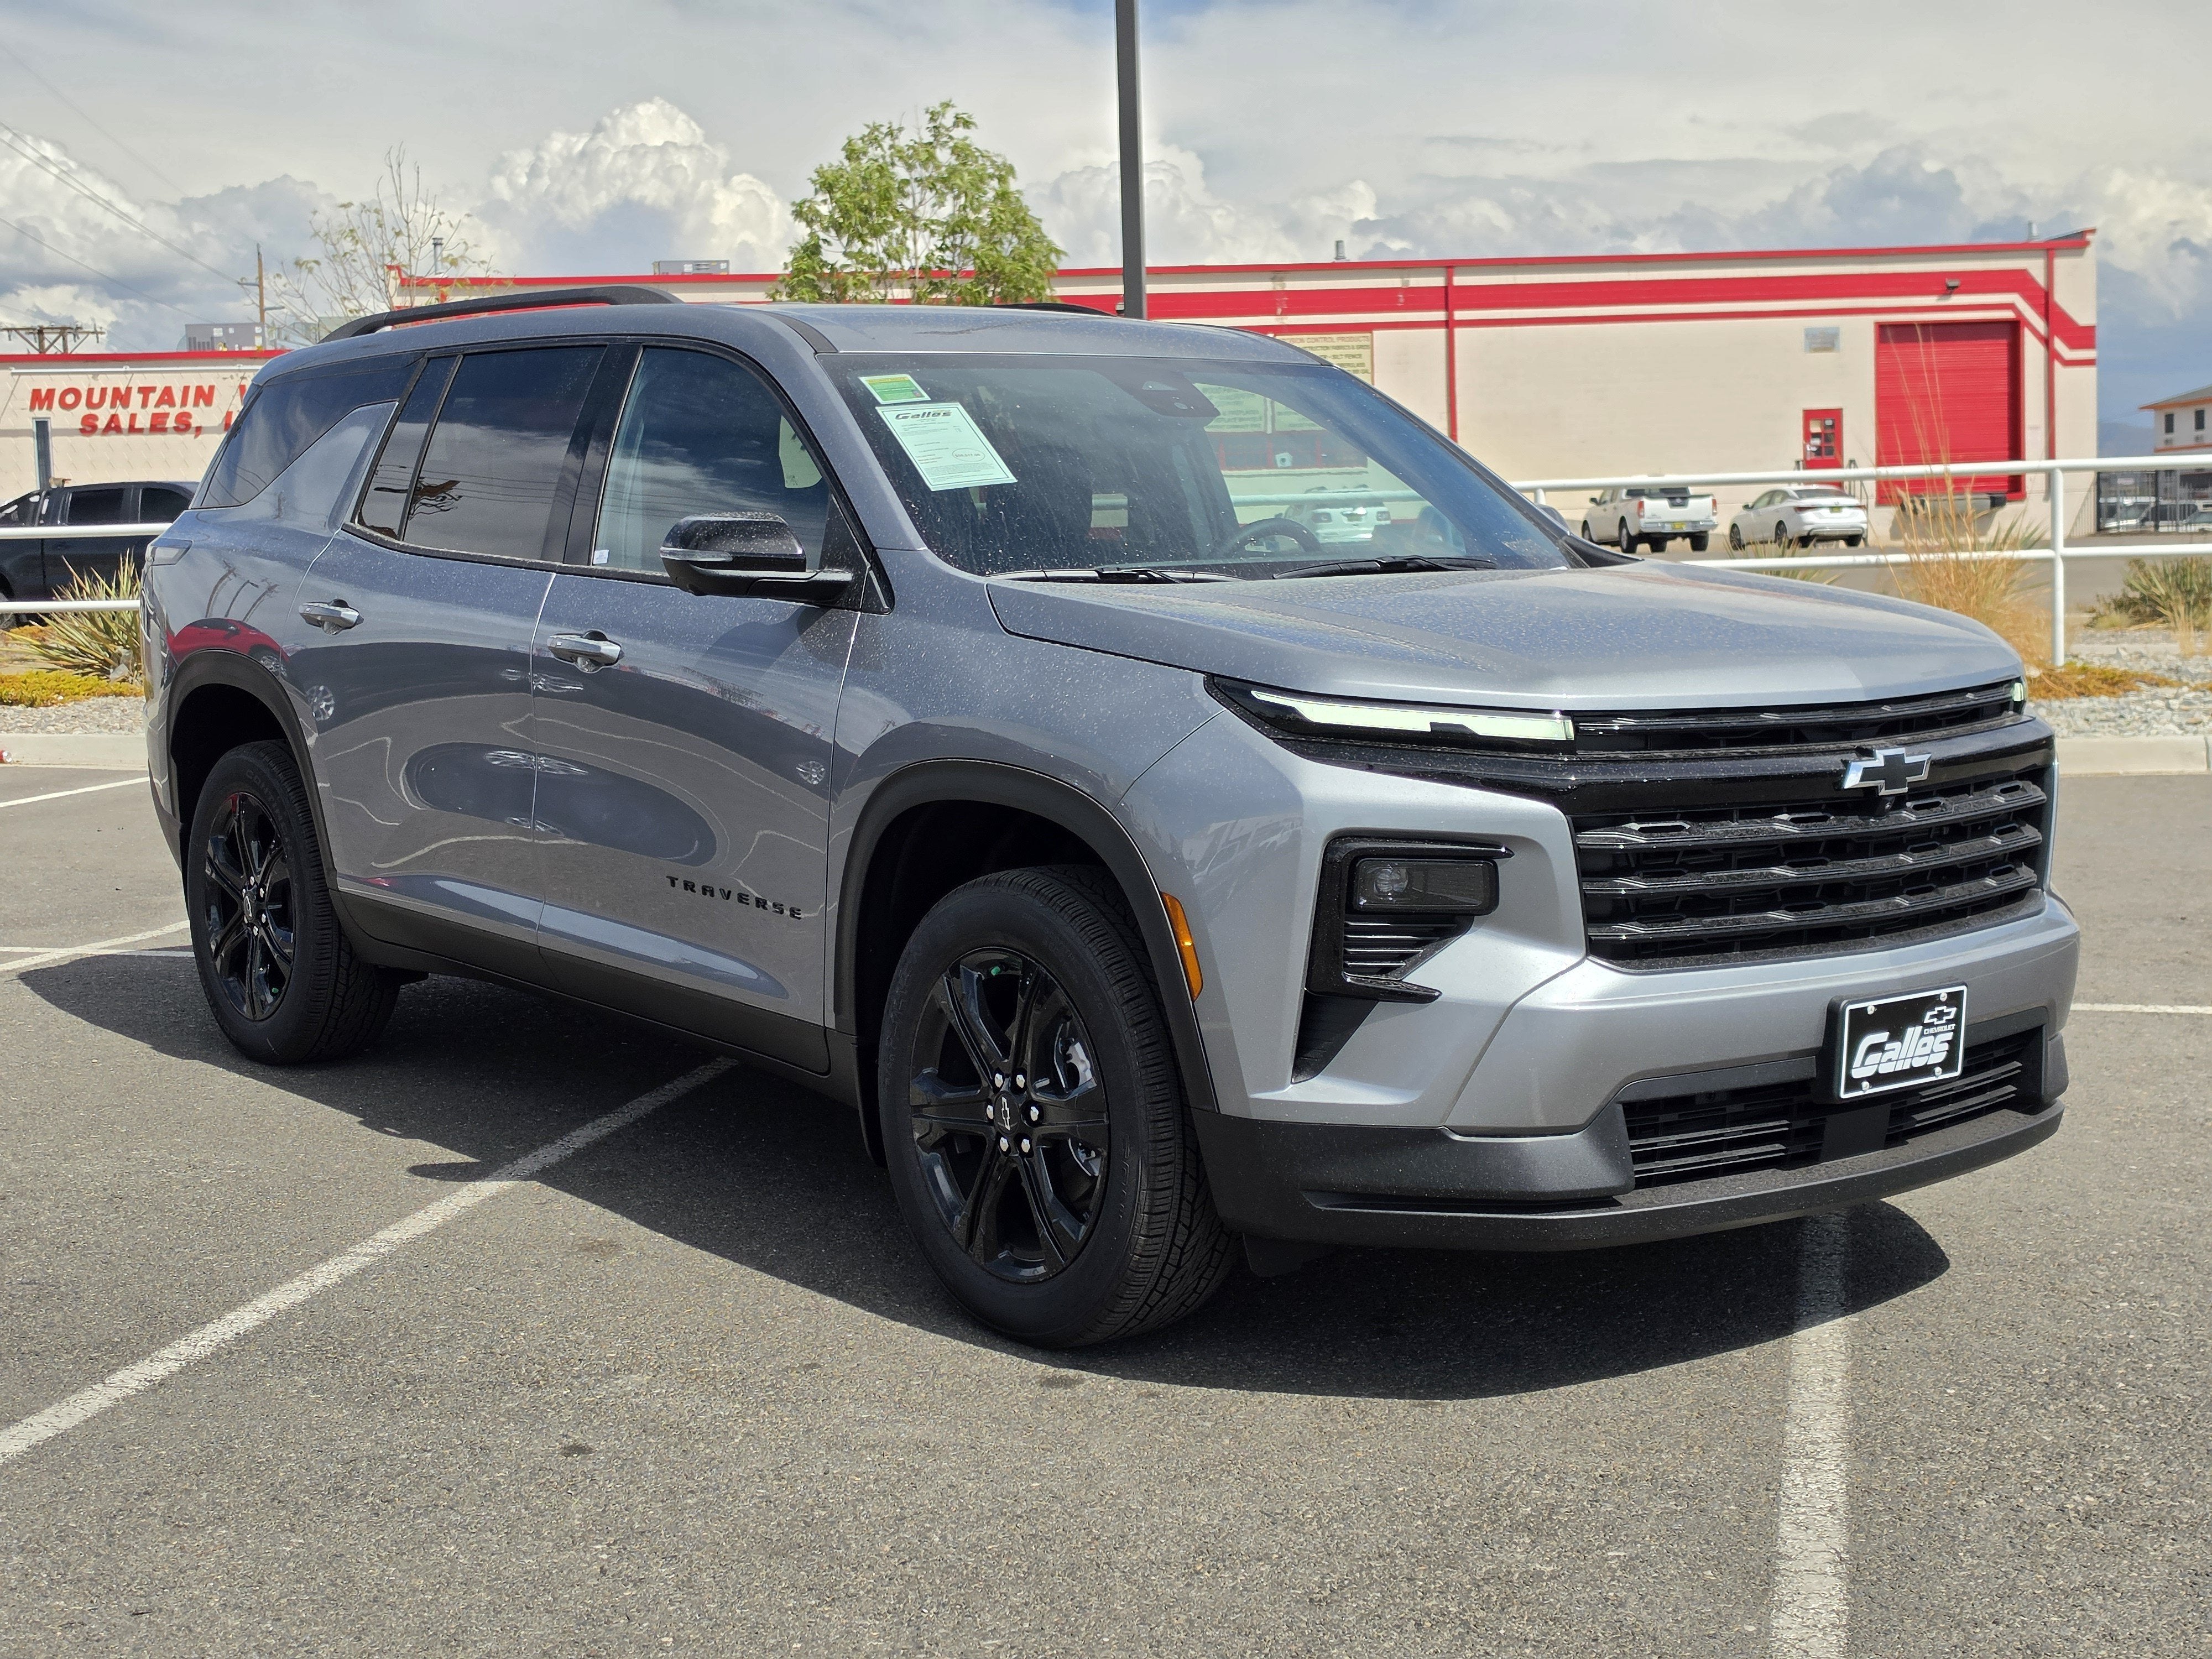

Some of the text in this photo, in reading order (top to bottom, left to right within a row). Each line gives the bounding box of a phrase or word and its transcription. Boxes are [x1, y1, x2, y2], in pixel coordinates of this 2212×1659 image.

[29, 385, 215, 411] MOUNTAIN
[79, 411, 202, 439] SALES,
[895, 411, 952, 420] Galles
[665, 875, 802, 920] TRAVERSE
[1923, 1024, 1956, 1035] CHEVROLET
[1851, 1026, 1954, 1079] Galles
